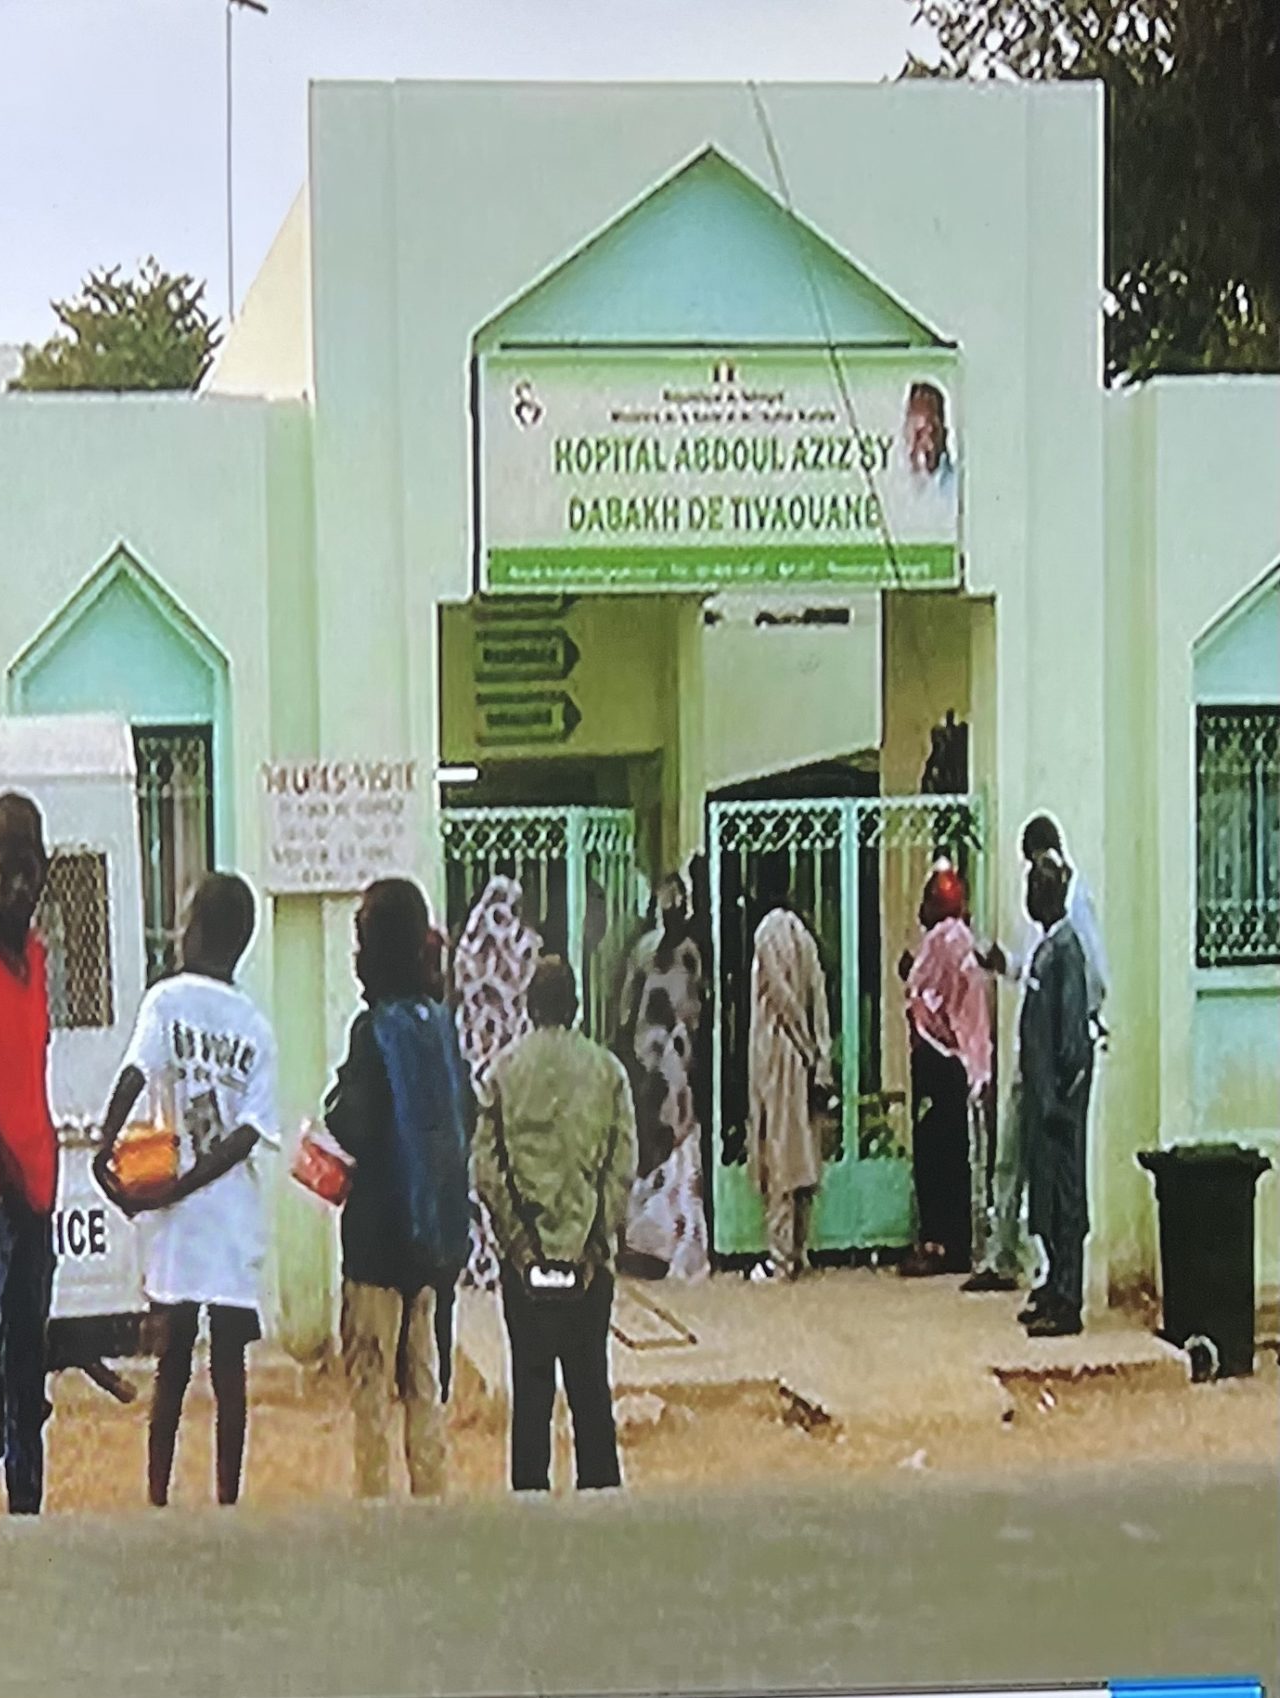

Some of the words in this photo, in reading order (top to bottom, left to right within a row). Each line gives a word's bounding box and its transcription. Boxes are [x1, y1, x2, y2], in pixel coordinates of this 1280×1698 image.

[554, 436, 668, 475] HOPITAL
[673, 436, 786, 474] ABDOUL
[790, 435, 853, 472] AZIZ
[857, 434, 894, 473] SY
[569, 495, 680, 532] DABAKH
[687, 495, 724, 531] DE
[56, 1209, 106, 1256] ICE
